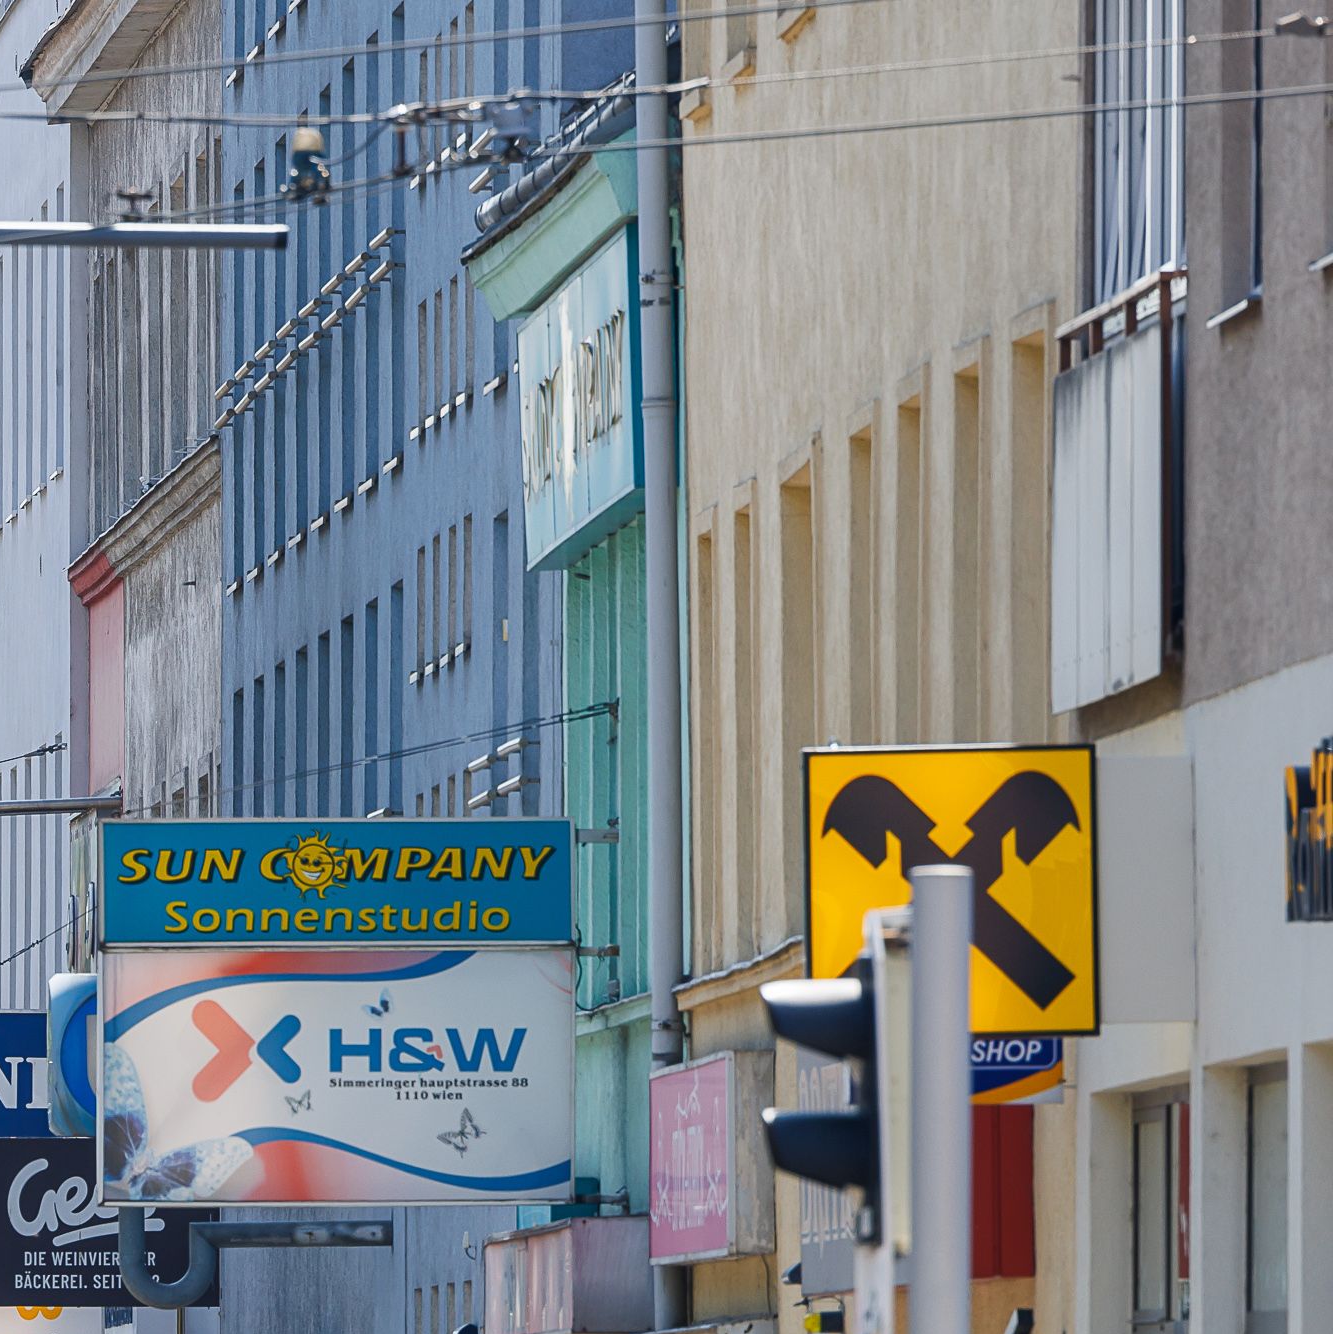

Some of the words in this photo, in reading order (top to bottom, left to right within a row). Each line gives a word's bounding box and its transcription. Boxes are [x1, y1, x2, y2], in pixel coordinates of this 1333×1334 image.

[118, 848, 245, 883] SUN
[164, 901, 511, 933] Sonnenstudio
[329, 1028, 527, 1072] H&W
[971, 1040, 1041, 1062] SHOP
[329, 1077, 417, 1089] Simmeringer
[419, 1077, 508, 1088] hauptstrasse
[511, 1077, 528, 1087] 88
[395, 1090, 429, 1100] 1110
[432, 1091, 463, 1100] wien
[24, 1252, 46, 1266] DIE
[15, 1271, 88, 1289] BÄCKEREI.
[93, 1274, 122, 1289] SEIT
